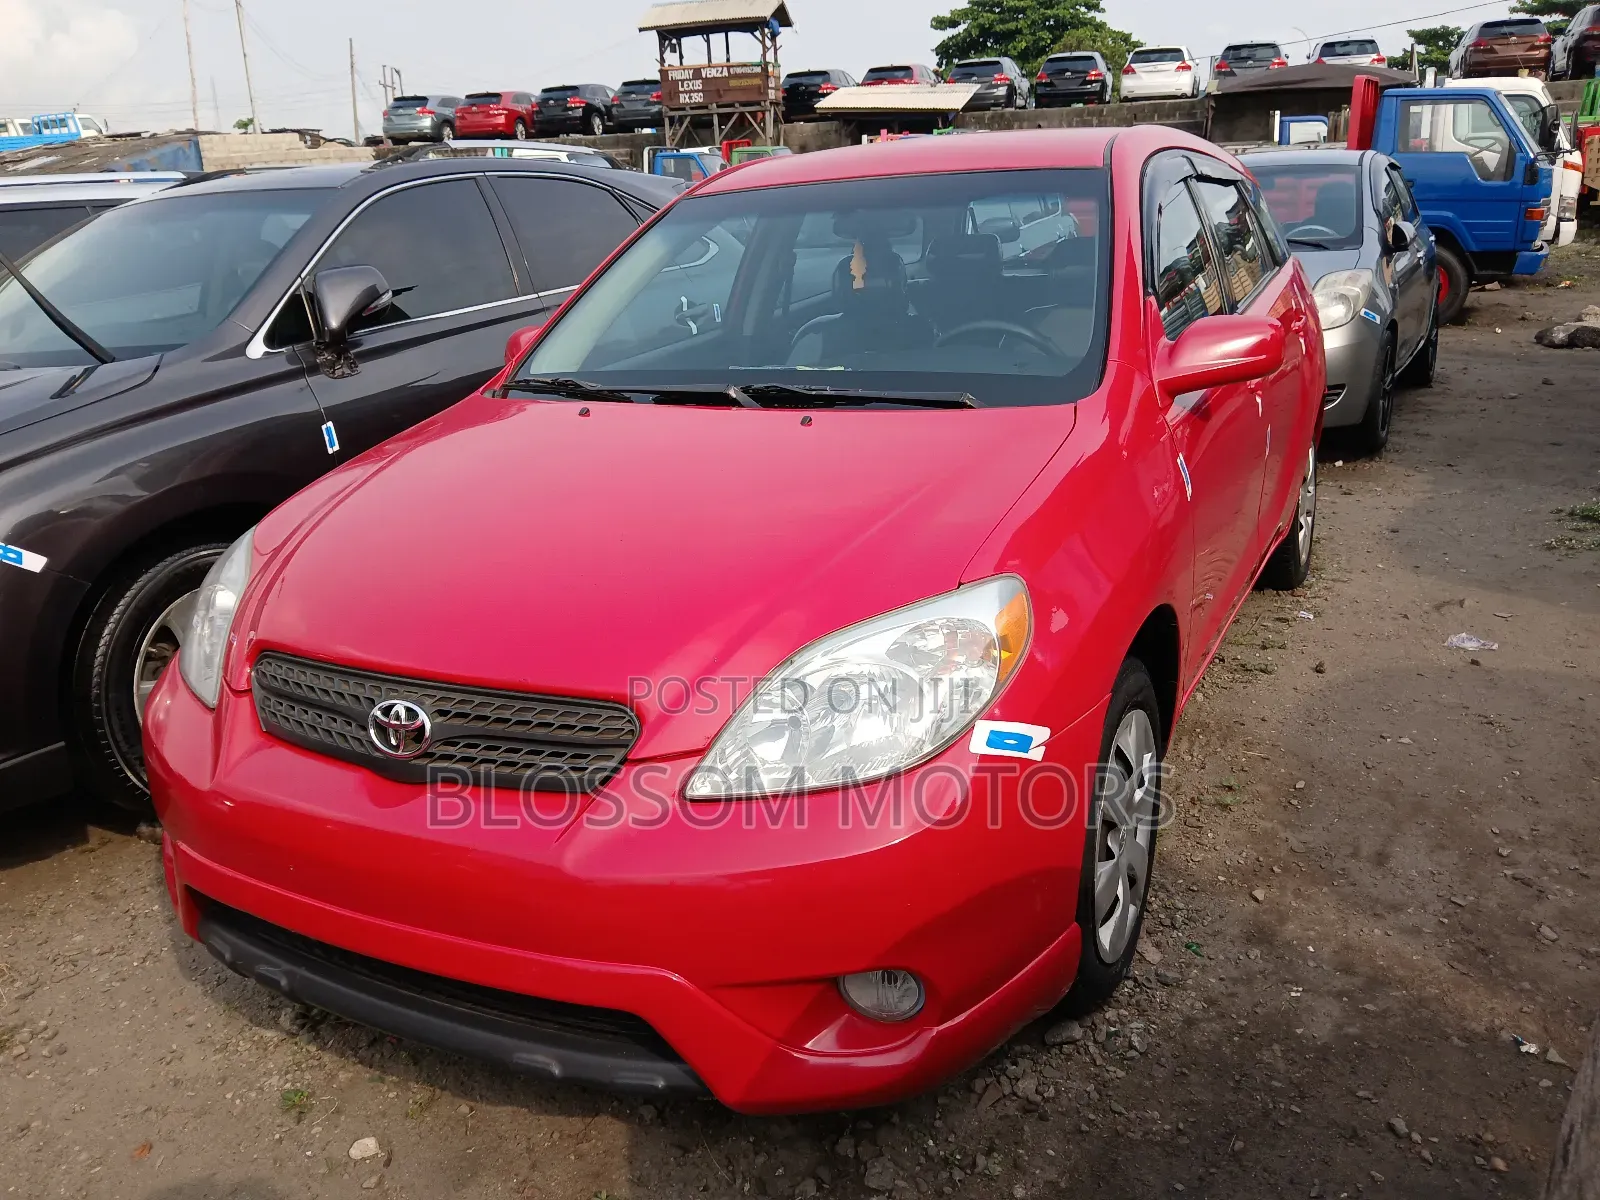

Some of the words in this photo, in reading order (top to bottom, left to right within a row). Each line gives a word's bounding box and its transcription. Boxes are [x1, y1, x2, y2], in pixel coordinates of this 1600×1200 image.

[668, 69, 694, 81] FRIDAY
[701, 66, 729, 79] VENZA
[678, 79, 703, 91] LEXUS
